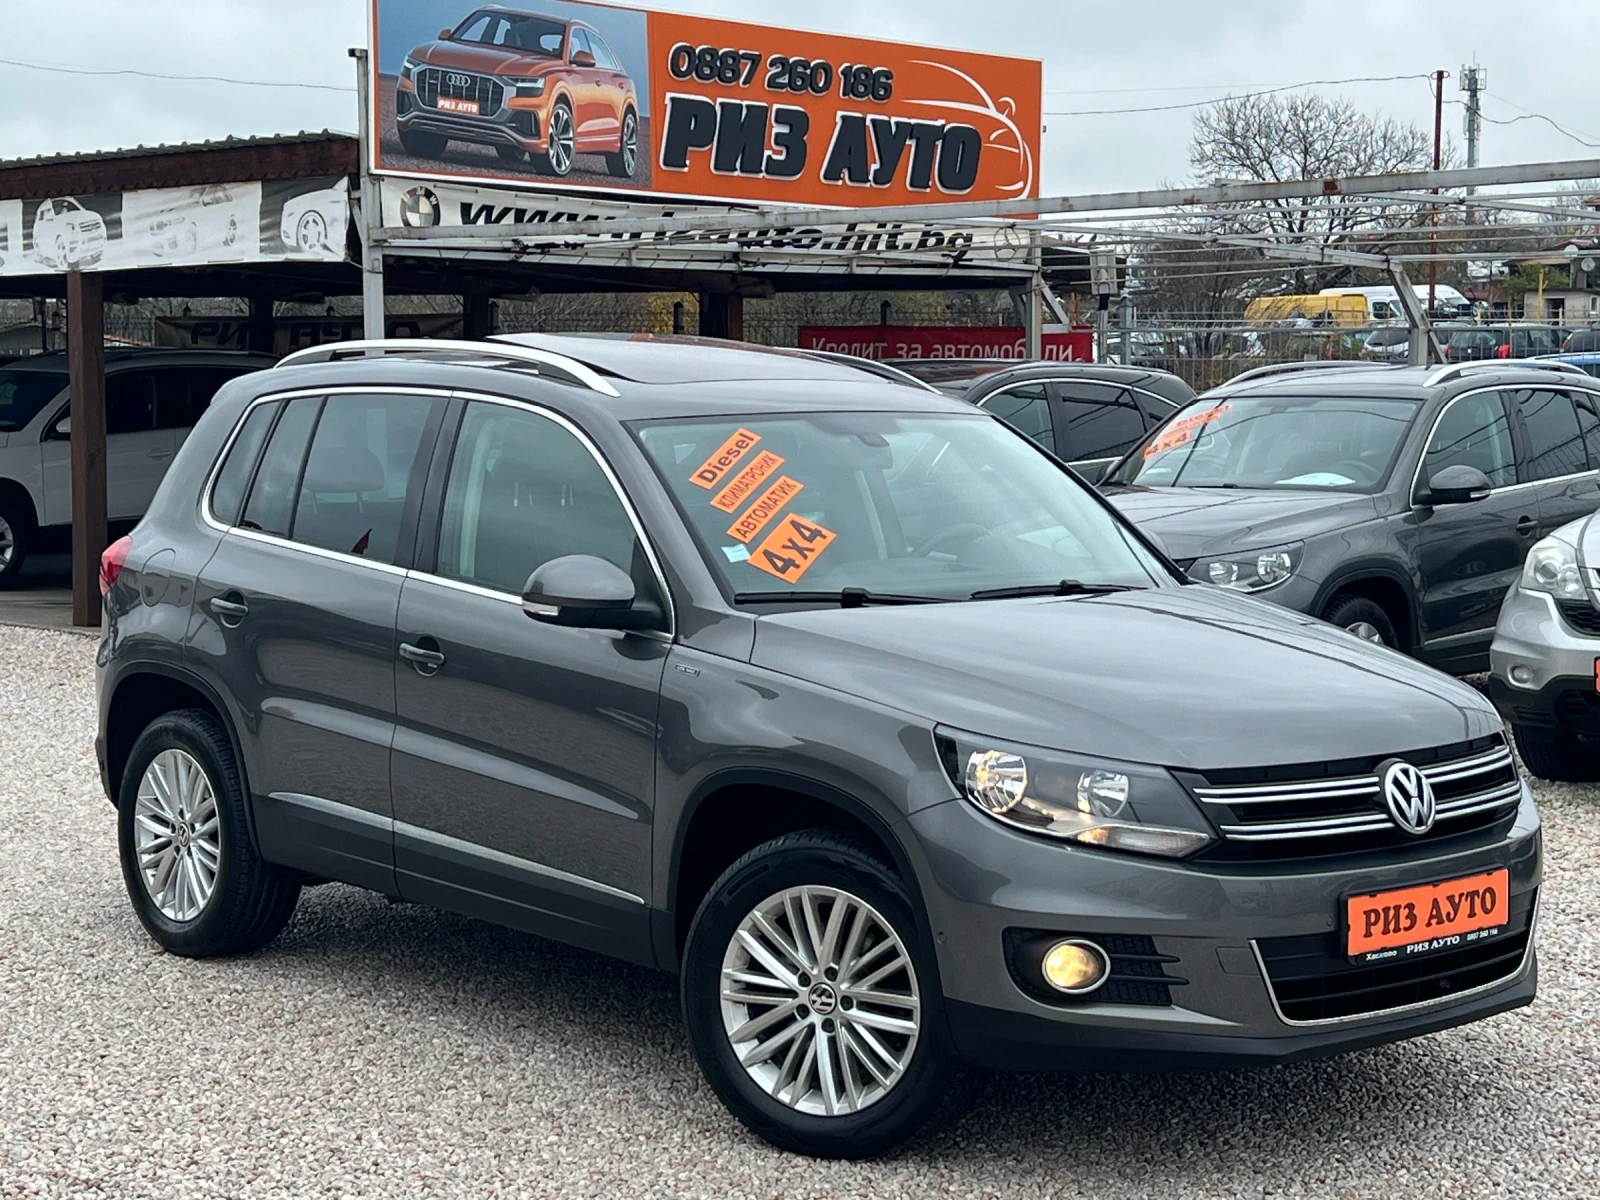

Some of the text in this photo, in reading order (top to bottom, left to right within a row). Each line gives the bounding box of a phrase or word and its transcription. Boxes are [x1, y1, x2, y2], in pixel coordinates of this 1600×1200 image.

[668, 42, 893, 101] 0887 260 186
[660, 92, 982, 194] РИЗ АУТО
[460, 202, 973, 266] ww.iuto.hit.bg
[191, 321, 421, 345] РИ АУО
[896, 342, 922, 359] за
[929, 338, 1073, 361] автомобли
[697, 433, 755, 484] Diesel
[719, 454, 779, 509] КЛИМАТРОНИК
[735, 480, 798, 539] АВТОМАТИК
[762, 519, 828, 575] 4x4
[1363, 887, 1497, 938] РИЗ АУТО
[1406, 935, 1460, 954] РИЗ АУТО
